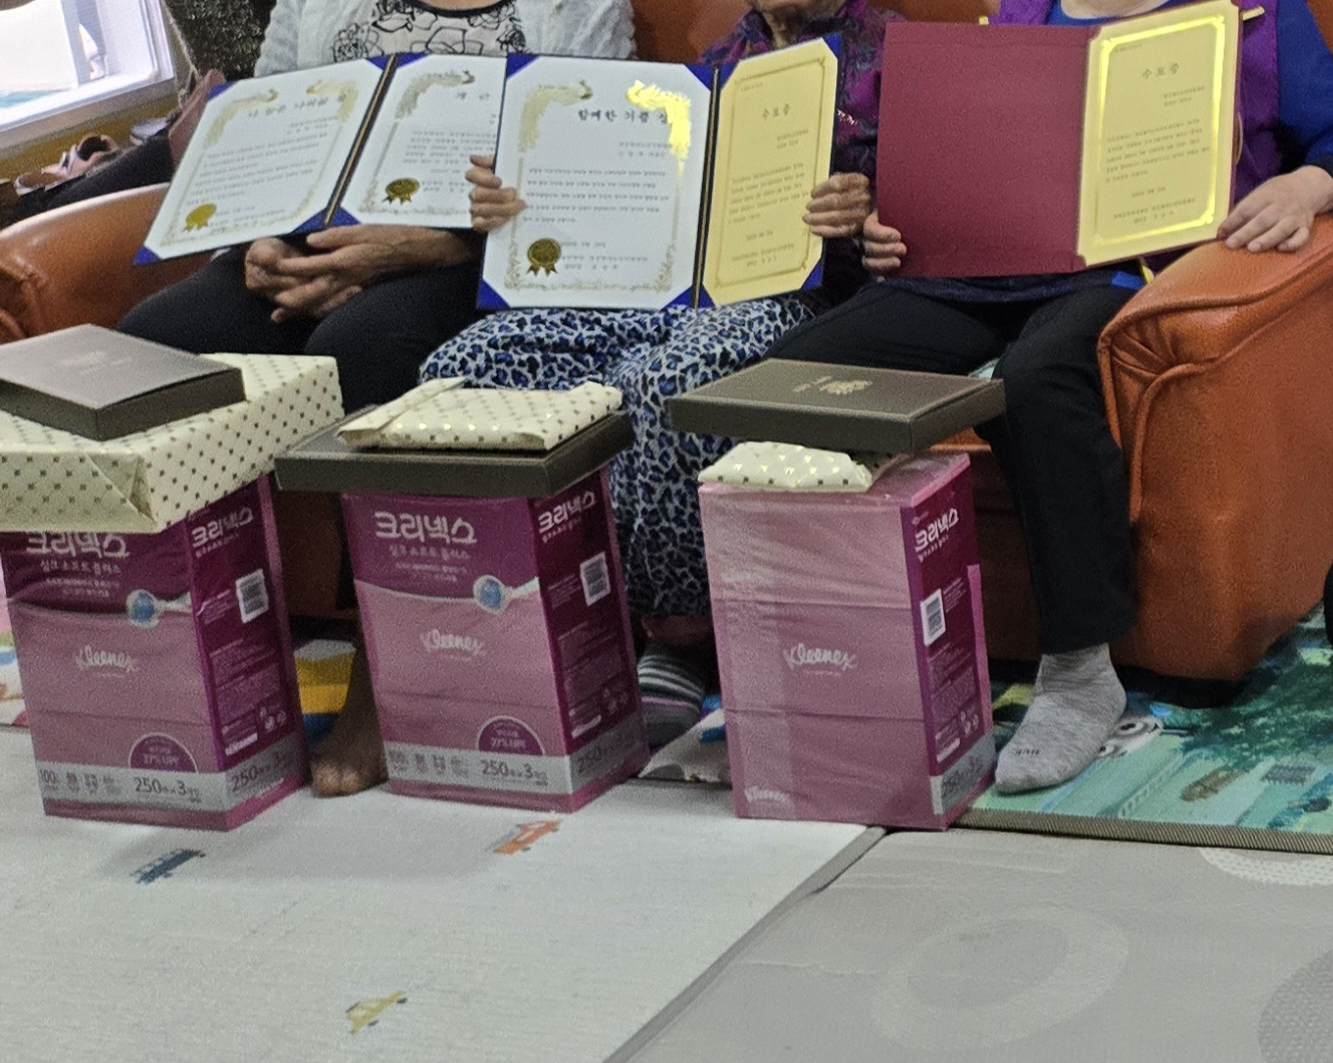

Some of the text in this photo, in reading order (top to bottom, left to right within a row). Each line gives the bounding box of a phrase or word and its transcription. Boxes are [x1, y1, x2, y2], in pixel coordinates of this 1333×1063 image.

[374, 510, 478, 545] 크리넥스
[420, 627, 488, 657] Kleenex
[783, 642, 857, 672] Kleenex
[75, 645, 139, 673] Kleenex
